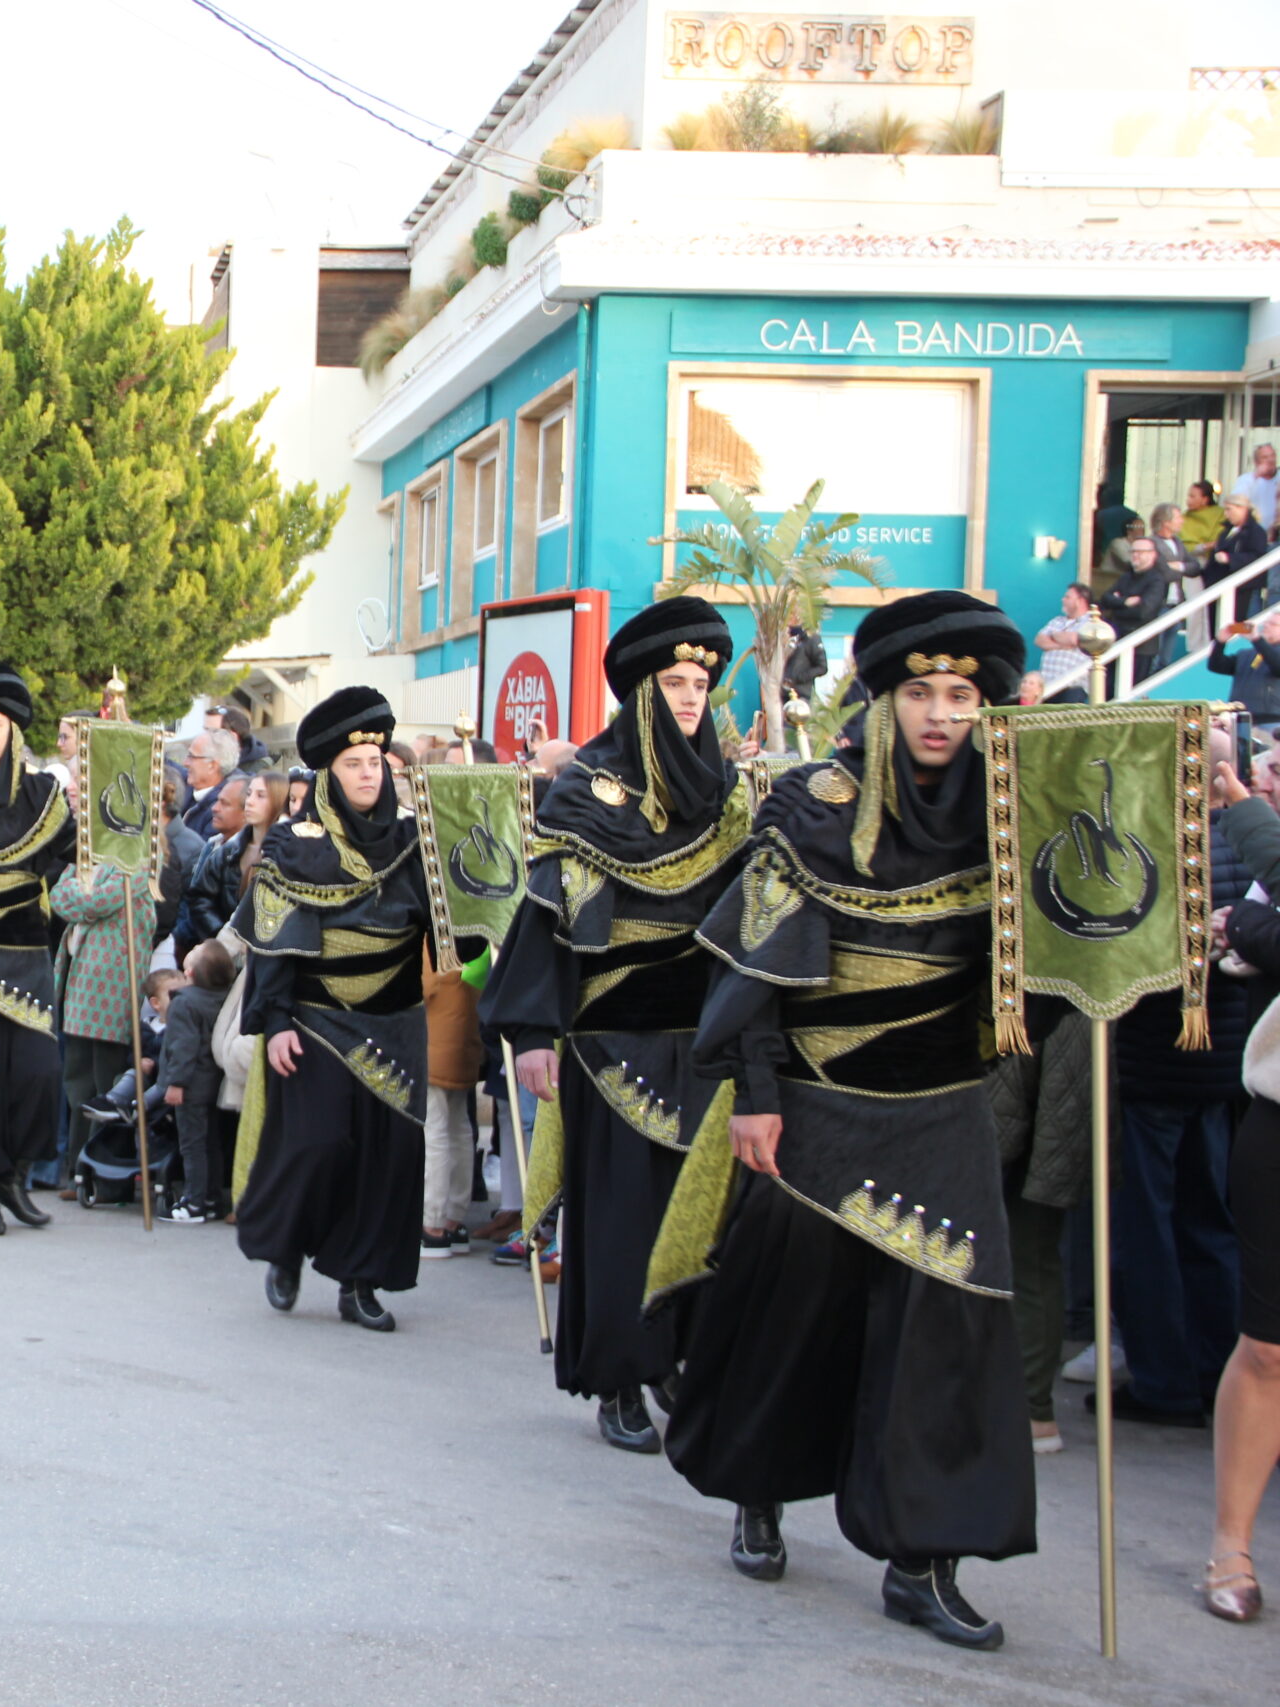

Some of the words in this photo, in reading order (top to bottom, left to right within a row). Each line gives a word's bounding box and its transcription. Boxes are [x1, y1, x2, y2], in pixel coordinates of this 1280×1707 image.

[669, 18, 972, 73] ROOFTOP
[760, 318, 877, 353] CALA
[895, 320, 1084, 355] BANDIDA
[800, 526, 851, 543] FOD
[856, 526, 933, 544] SERVICE
[506, 670, 547, 704] XÀBIA
[505, 705, 514, 721] EN
